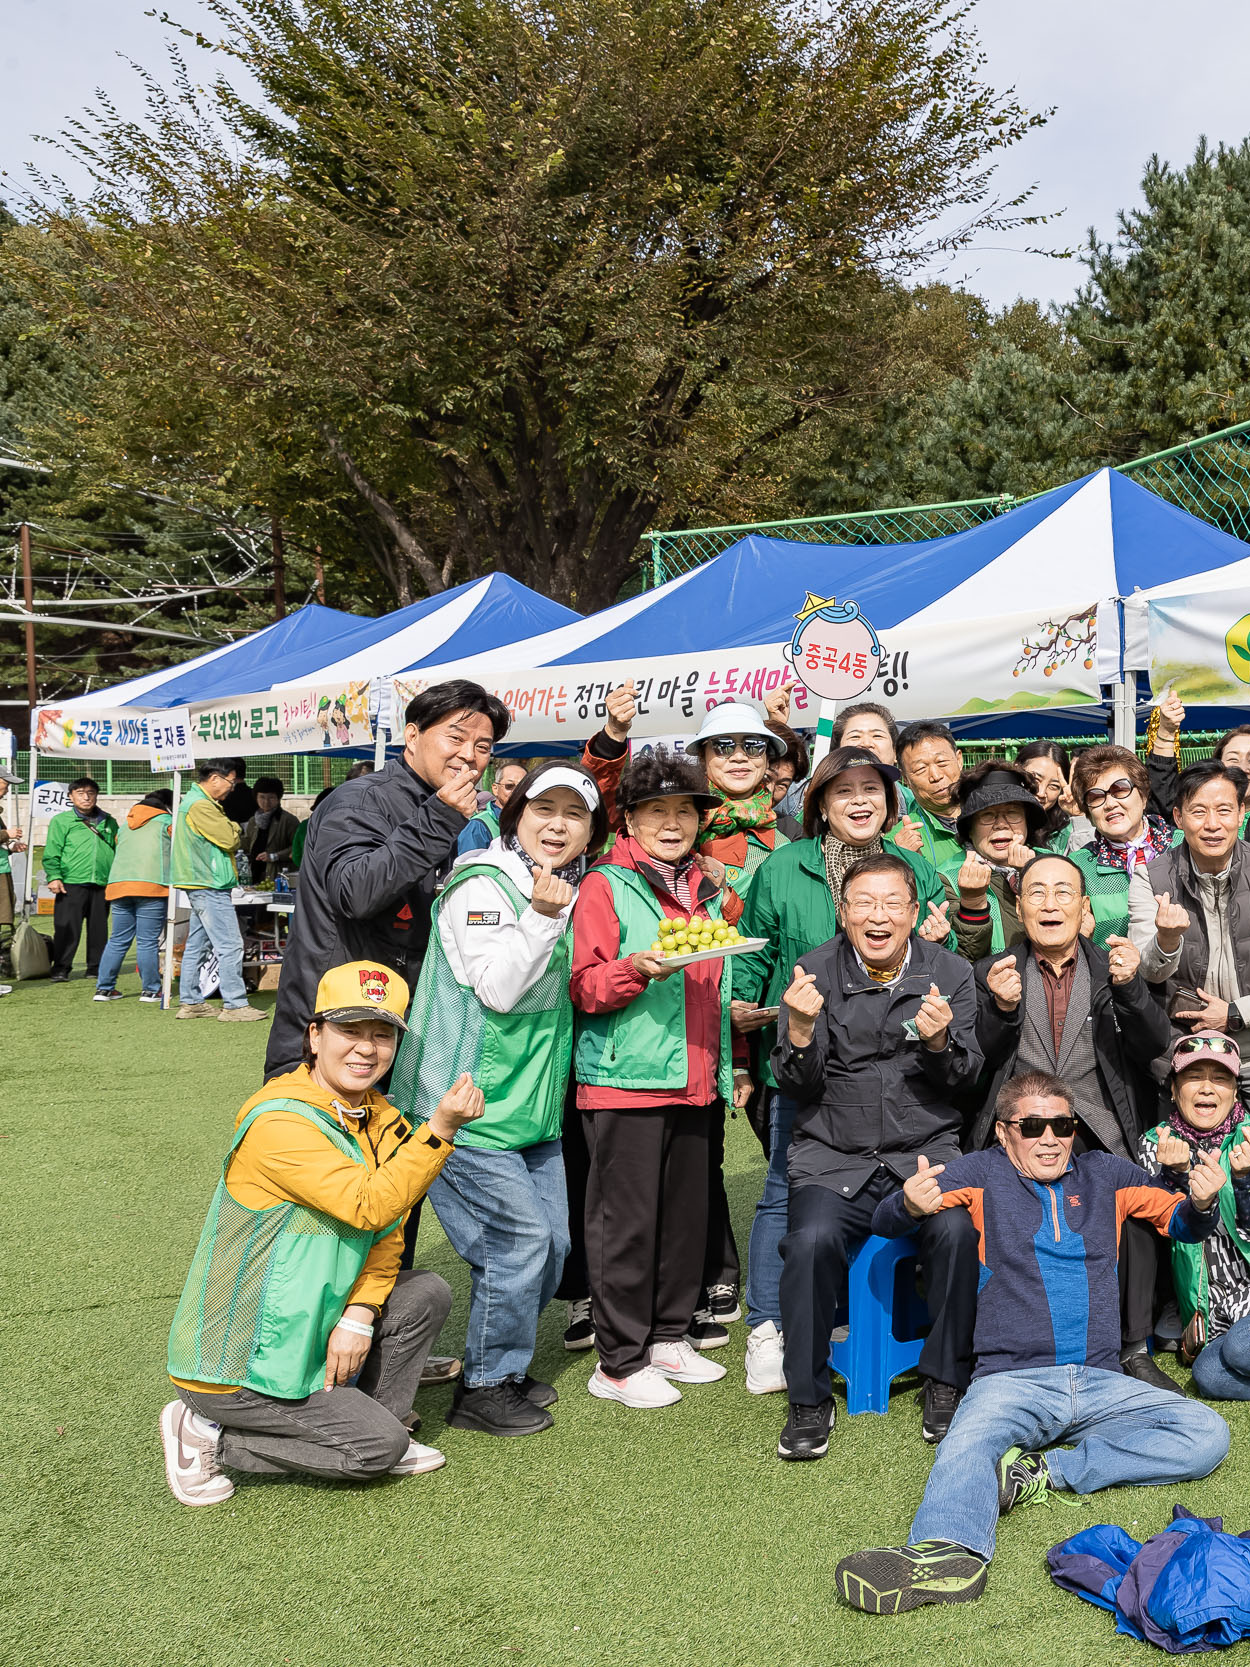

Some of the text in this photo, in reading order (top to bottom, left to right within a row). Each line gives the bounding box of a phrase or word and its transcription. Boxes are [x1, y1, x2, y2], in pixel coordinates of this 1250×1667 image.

[805, 642, 869, 680] 중곡4동
[574, 678, 654, 719] 정감린
[657, 670, 699, 717] 마을
[76, 719, 112, 746] 군자동
[153, 725, 186, 749] 군자동
[359, 969, 390, 987] POP
[366, 988, 386, 996] USA
